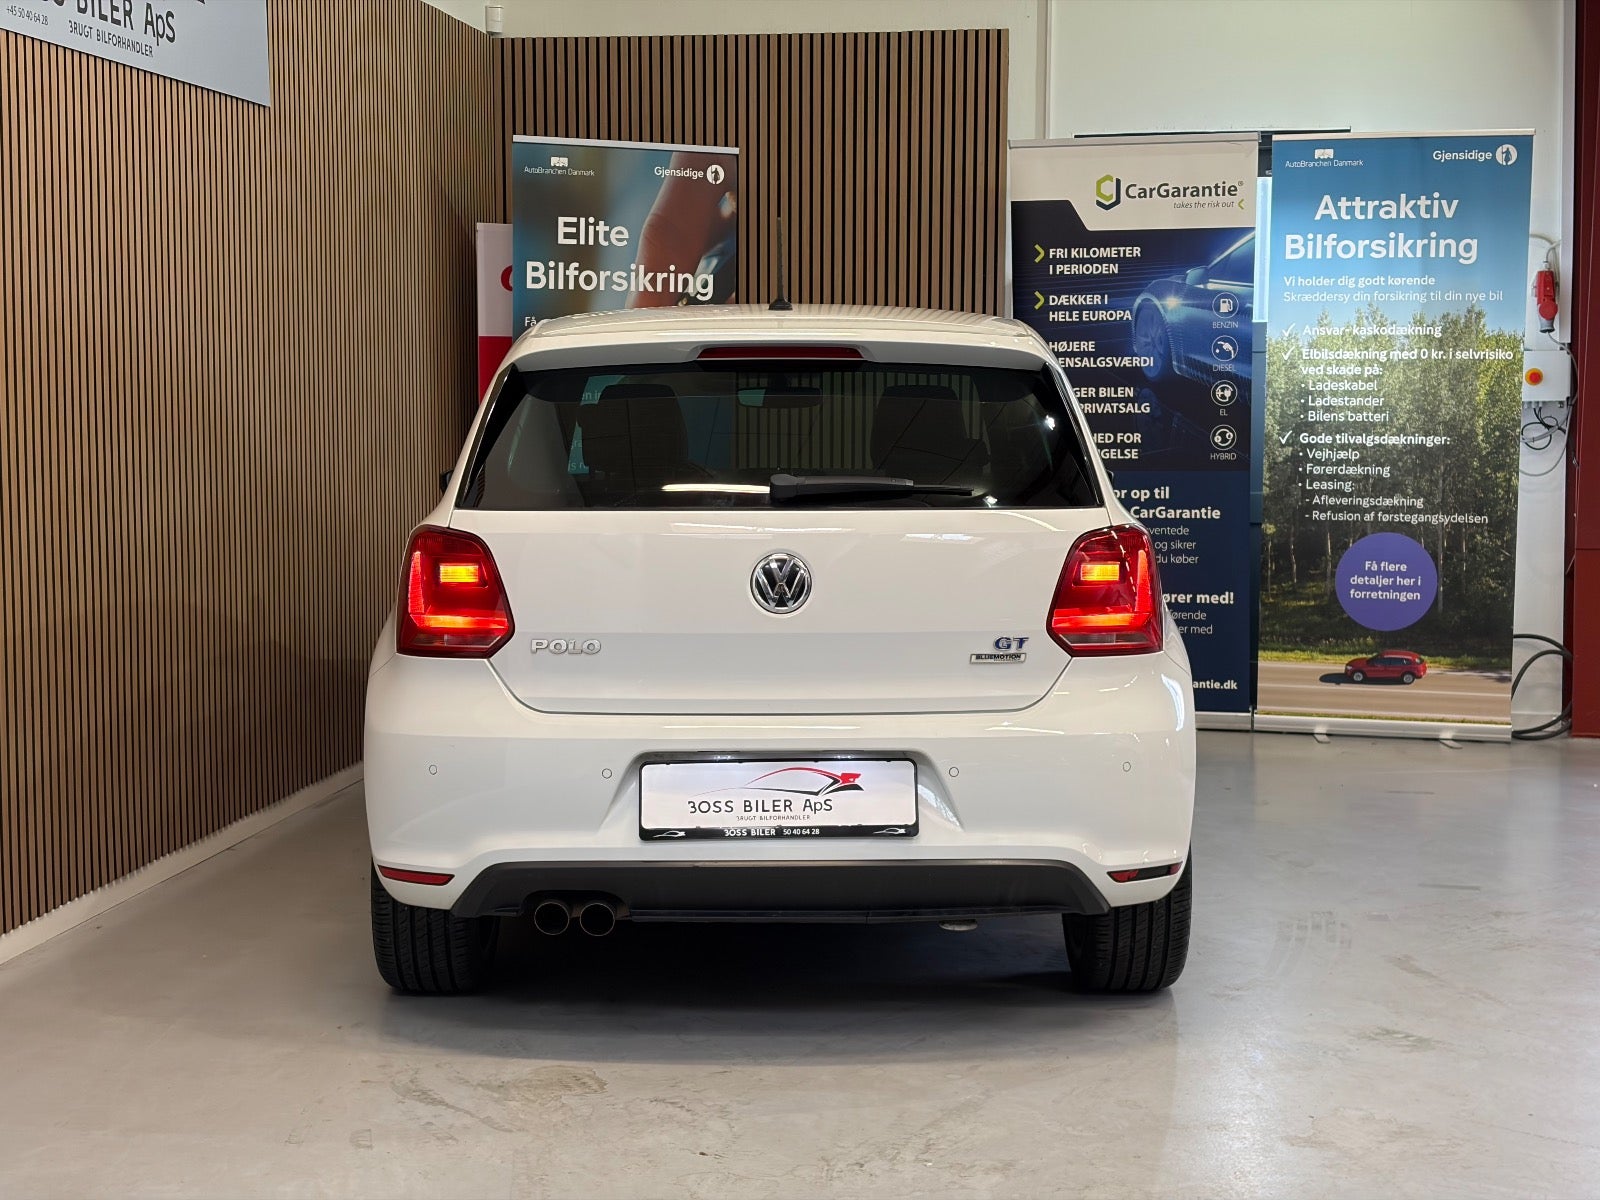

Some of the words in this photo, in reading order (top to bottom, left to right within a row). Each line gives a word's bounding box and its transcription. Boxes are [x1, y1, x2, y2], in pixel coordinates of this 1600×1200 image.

[144, 2, 176, 46] ApS
[96, 28, 154, 58] BILFORHANDLER
[1432, 150, 1492, 162] Gjensidige
[1285, 160, 1332, 168] AutoBranchen
[1334, 158, 1364, 168] Danmark
[568, 168, 595, 176] Danmark
[654, 166, 704, 179] Gjensidige
[1194, 200, 1206, 208] the
[1207, 200, 1220, 208] risk
[1314, 192, 1459, 220] Attraktiv
[557, 216, 629, 247] Elite
[1049, 248, 1068, 259] FRI
[1071, 247, 1141, 258] KILOMETER
[1284, 231, 1478, 264] Bilforsikring
[1056, 264, 1118, 275] PERIODEN
[526, 260, 714, 301] Bilforsikring
[1284, 276, 1296, 286] Vi
[1298, 276, 1335, 286] holder
[1338, 275, 1356, 288] dig
[1358, 275, 1385, 288] godt
[1387, 275, 1436, 286] kørende
[1049, 294, 1102, 306] DÆKKER
[1284, 292, 1350, 304] Skræddersy
[1353, 291, 1371, 302] din
[1374, 291, 1427, 303] forsikring
[1430, 290, 1442, 302] til
[1444, 290, 1462, 301] din
[1465, 292, 1486, 304] nye
[1489, 290, 1503, 301] bil
[524, 316, 537, 328] Få
[1049, 311, 1080, 322] HELE
[1084, 310, 1132, 321] EUROPA
[1212, 321, 1239, 329] BENZIN
[1353, 324, 1442, 338] kaskodækning
[1049, 341, 1096, 352] HØJERE
[1302, 349, 1387, 362] Elbilsdækning
[1390, 349, 1418, 360] med
[1420, 349, 1428, 360] 0
[1431, 348, 1446, 360] kr.
[1455, 348, 1514, 360] selvrisiko
[1058, 356, 1154, 368] ENSALGSVÆRDI
[1212, 364, 1237, 372] DIESEL
[1301, 364, 1324, 376] ved
[1326, 364, 1362, 376] skade
[1364, 364, 1382, 378] på:
[1308, 380, 1378, 391] Ladeskabel
[1073, 387, 1096, 398] GER
[1099, 387, 1134, 398] BILEN
[1308, 396, 1384, 406] Ladestander
[1219, 408, 1228, 416] EL
[1308, 411, 1345, 422] Bilens
[1348, 410, 1390, 422] batteri
[1117, 433, 1142, 444] FOR
[1299, 433, 1333, 444] Gode
[1335, 433, 1450, 448] tilvalgsdækninger:
[1210, 452, 1237, 460] HYBRID
[1306, 448, 1360, 462] Vejhjælp
[1306, 464, 1391, 478] Førerdækning
[1306, 480, 1355, 493] Leasing:
[1130, 489, 1150, 502] op
[1154, 486, 1170, 499] til
[1312, 495, 1424, 509] Afleveringsdækning
[1130, 506, 1221, 519] CarGarantie
[1312, 510, 1361, 522] Refusion
[1363, 511, 1375, 522] af
[1377, 511, 1488, 526] førstegangsydelsen
[1148, 525, 1190, 536] ventede
[1154, 541, 1168, 552] og
[1170, 540, 1197, 550] sikrer
[1170, 554, 1199, 564] køber
[1365, 561, 1378, 571] Få
[1380, 561, 1408, 572] flere
[1350, 574, 1394, 588] detaljer
[1396, 576, 1416, 586] her
[1163, 593, 1193, 604] ører
[1196, 592, 1234, 604] med!
[1350, 589, 1421, 602] forretningen
[1170, 610, 1207, 620] ørende
[1178, 626, 1188, 634] er
[1190, 624, 1213, 634] med
[531, 639, 601, 655] POLO
[994, 636, 1029, 651] GT
[1192, 680, 1238, 690] antie.dk
[743, 799, 793, 813] BILER
[802, 798, 833, 815] ApS
[750, 828, 776, 836] BILER
